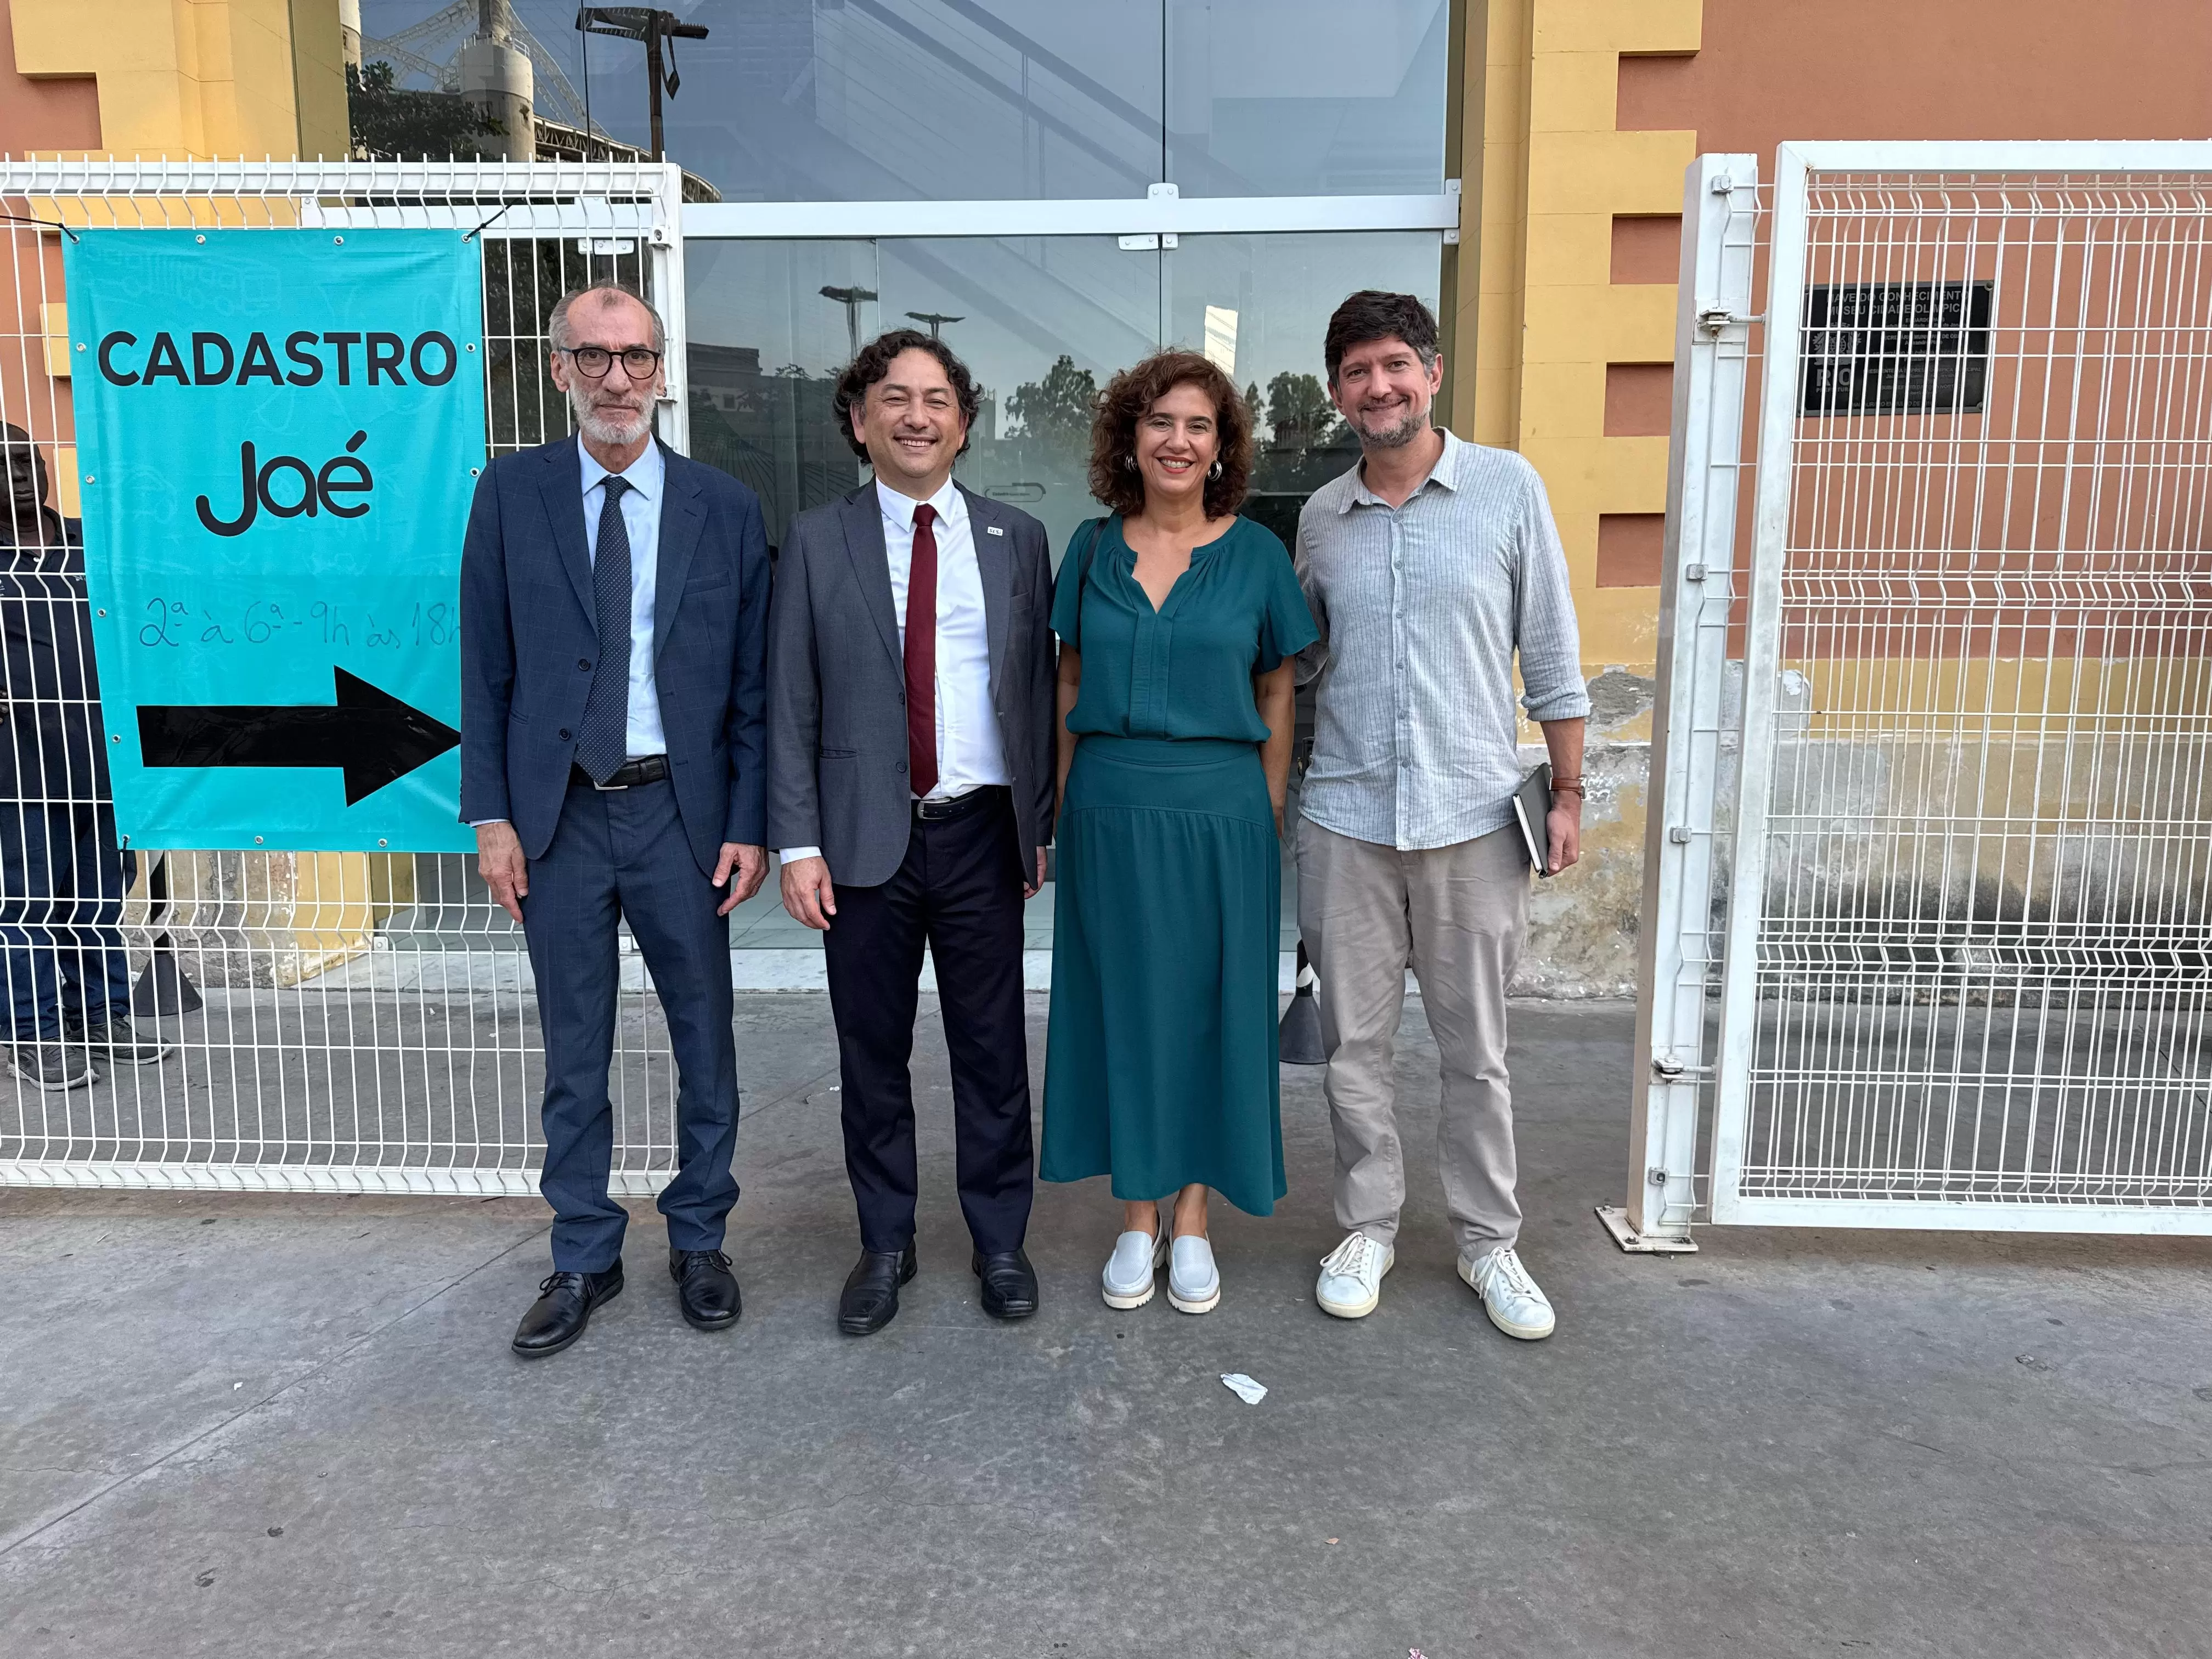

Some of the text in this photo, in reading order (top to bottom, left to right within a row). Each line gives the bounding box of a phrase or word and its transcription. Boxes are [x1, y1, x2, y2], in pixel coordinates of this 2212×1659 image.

[1914, 303, 1970, 313] OLMPIC
[98, 331, 457, 387] CADASTRO
[1816, 368, 1851, 387] RO
[195, 430, 373, 537] Jaé
[310, 601, 350, 646] 9h
